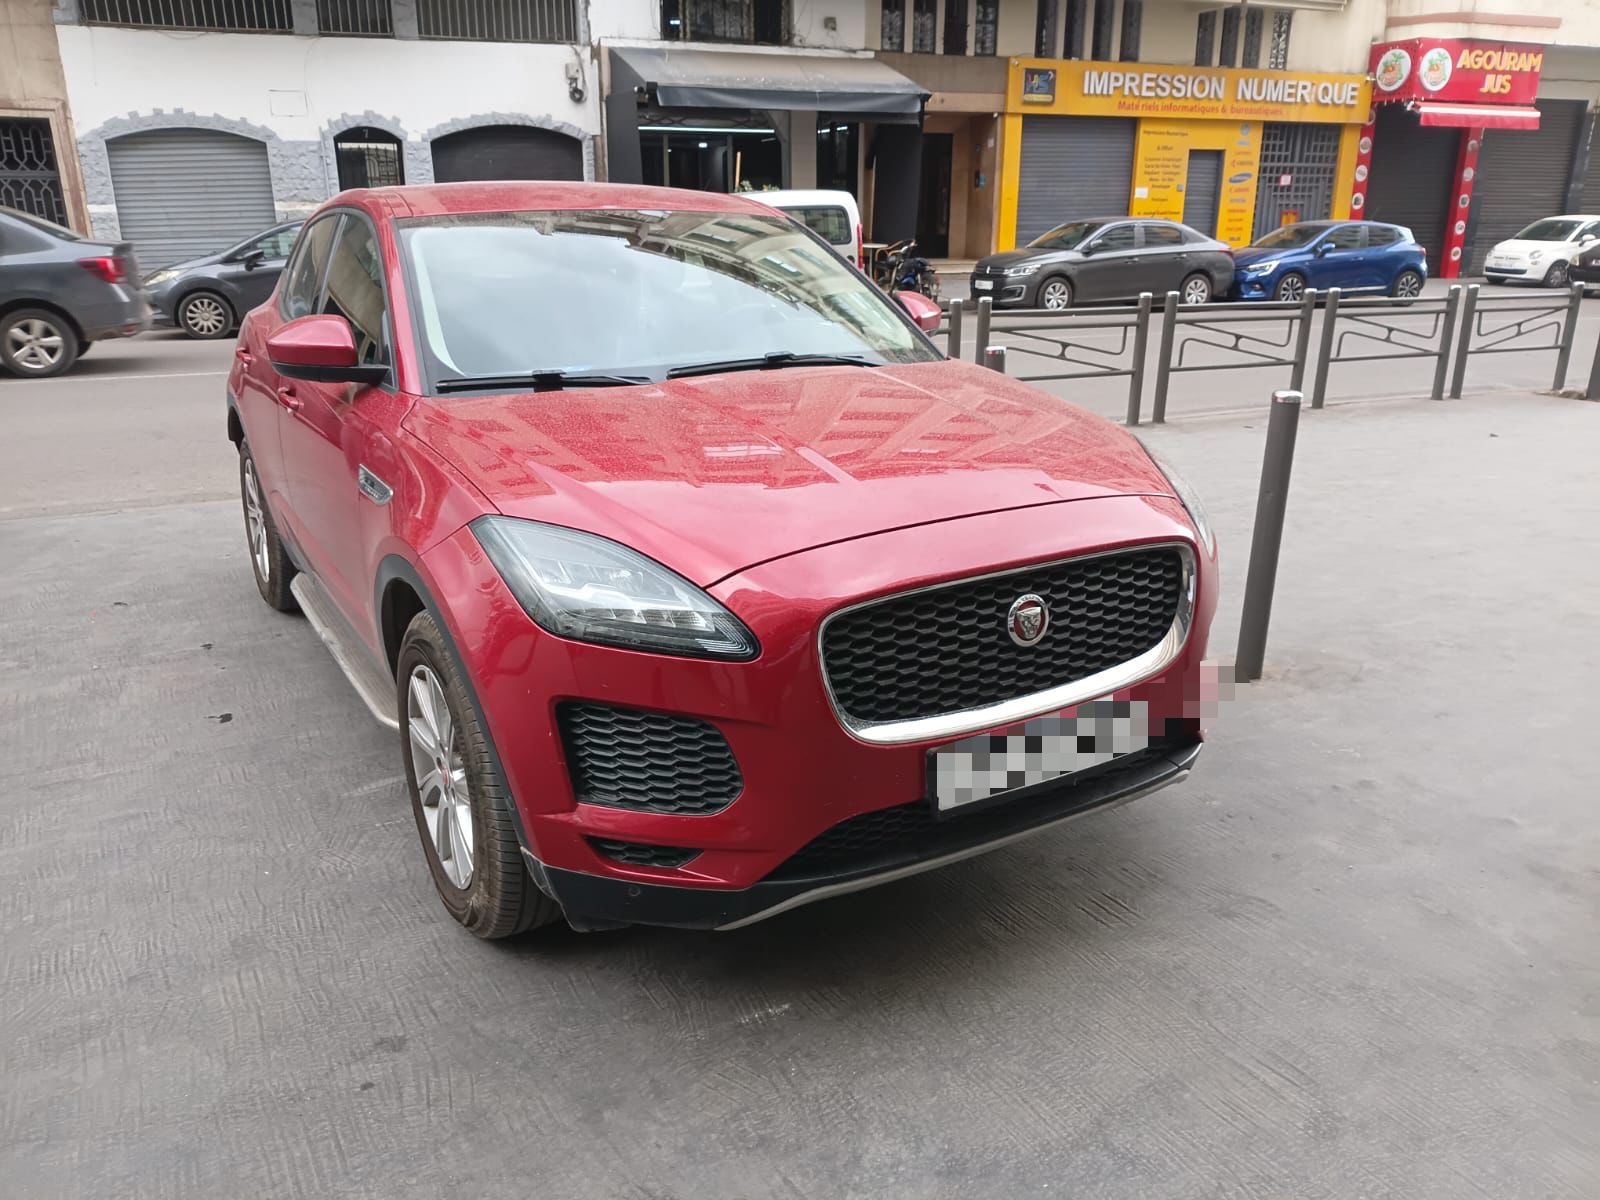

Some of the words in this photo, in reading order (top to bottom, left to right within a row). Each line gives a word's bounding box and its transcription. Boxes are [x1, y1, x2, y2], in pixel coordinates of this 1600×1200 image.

[1456, 48, 1543, 73] AGOURAM
[1083, 70, 1225, 99] IMPRESSION
[1479, 73, 1512, 95] JUS
[1161, 103, 1218, 115] informatiques
